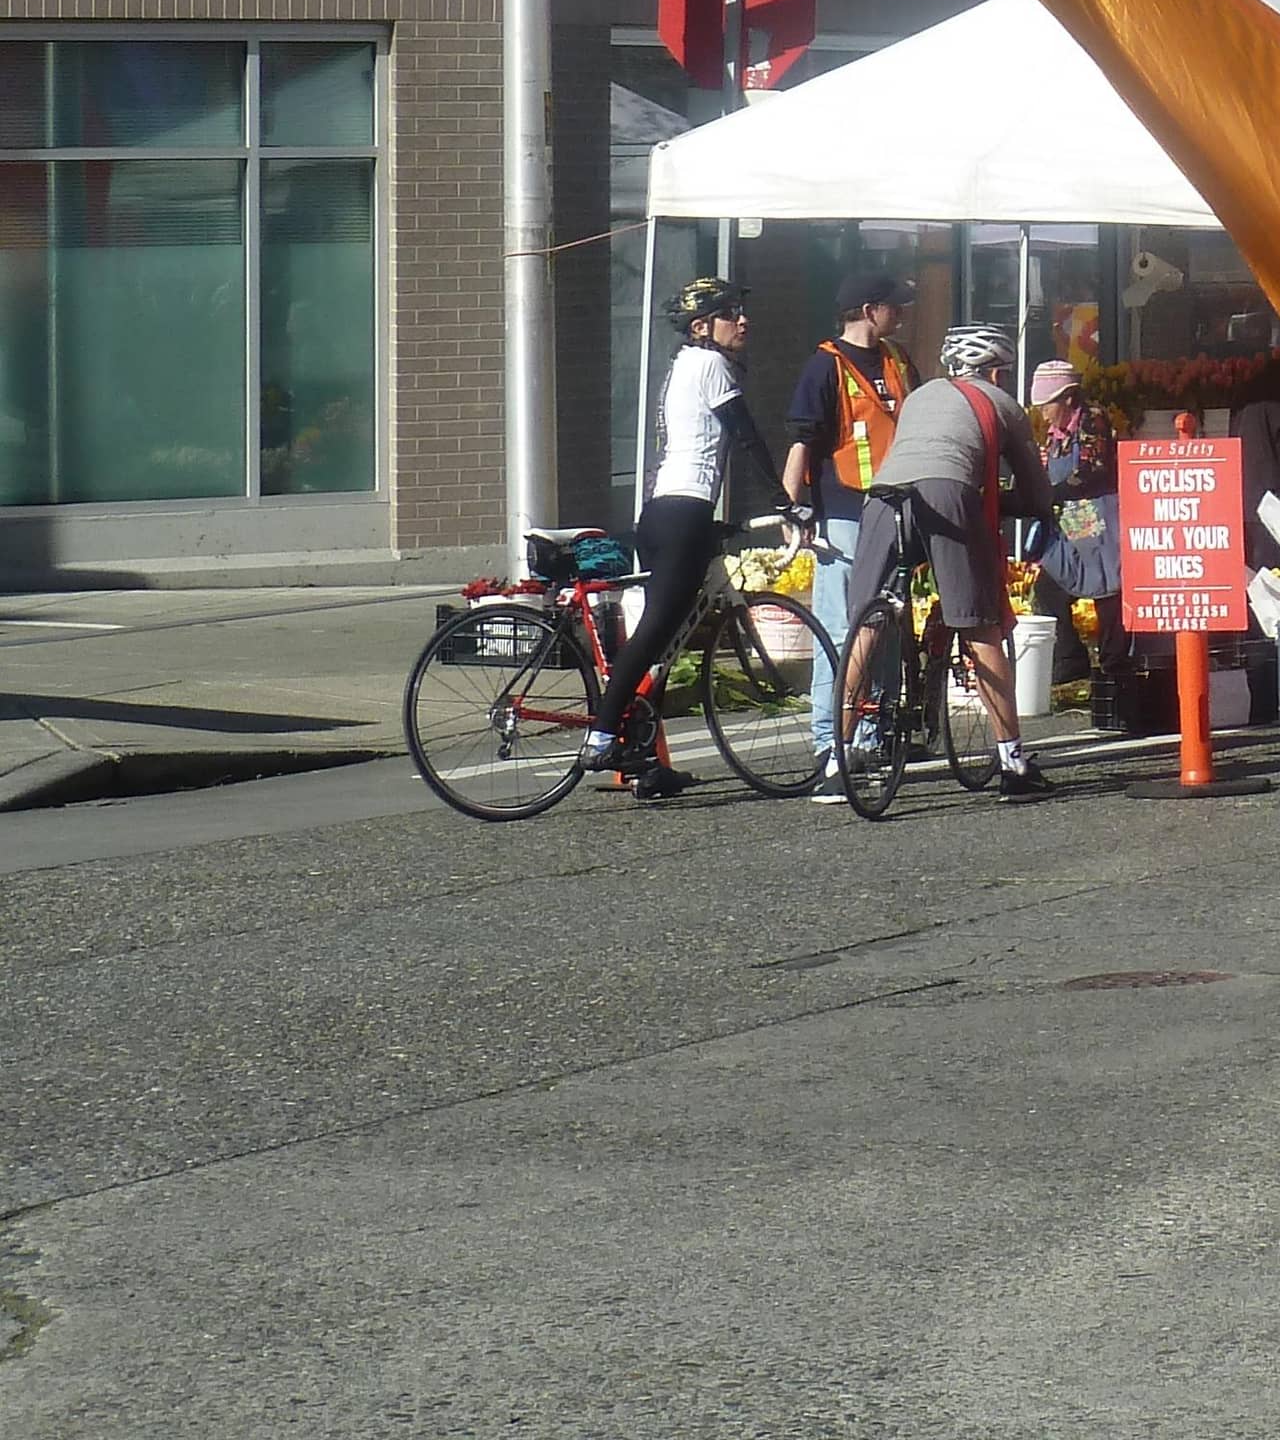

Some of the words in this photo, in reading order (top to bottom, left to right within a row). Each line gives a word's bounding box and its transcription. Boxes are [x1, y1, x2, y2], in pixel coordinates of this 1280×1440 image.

[1140, 443, 1162, 456] For
[1168, 442, 1214, 457] Safety
[1138, 468, 1216, 493] CYCLISTS
[1153, 498, 1200, 522] MUST
[1129, 527, 1175, 551] WALK
[1182, 526, 1230, 550] YOUR
[1154, 556, 1204, 579] BIKES
[1152, 593, 1185, 606] PETS
[1191, 593, 1210, 605] ON
[1137, 606, 1178, 618] SHORT
[1185, 605, 1228, 617] LEASH
[1157, 618, 1208, 631] PLEASE
